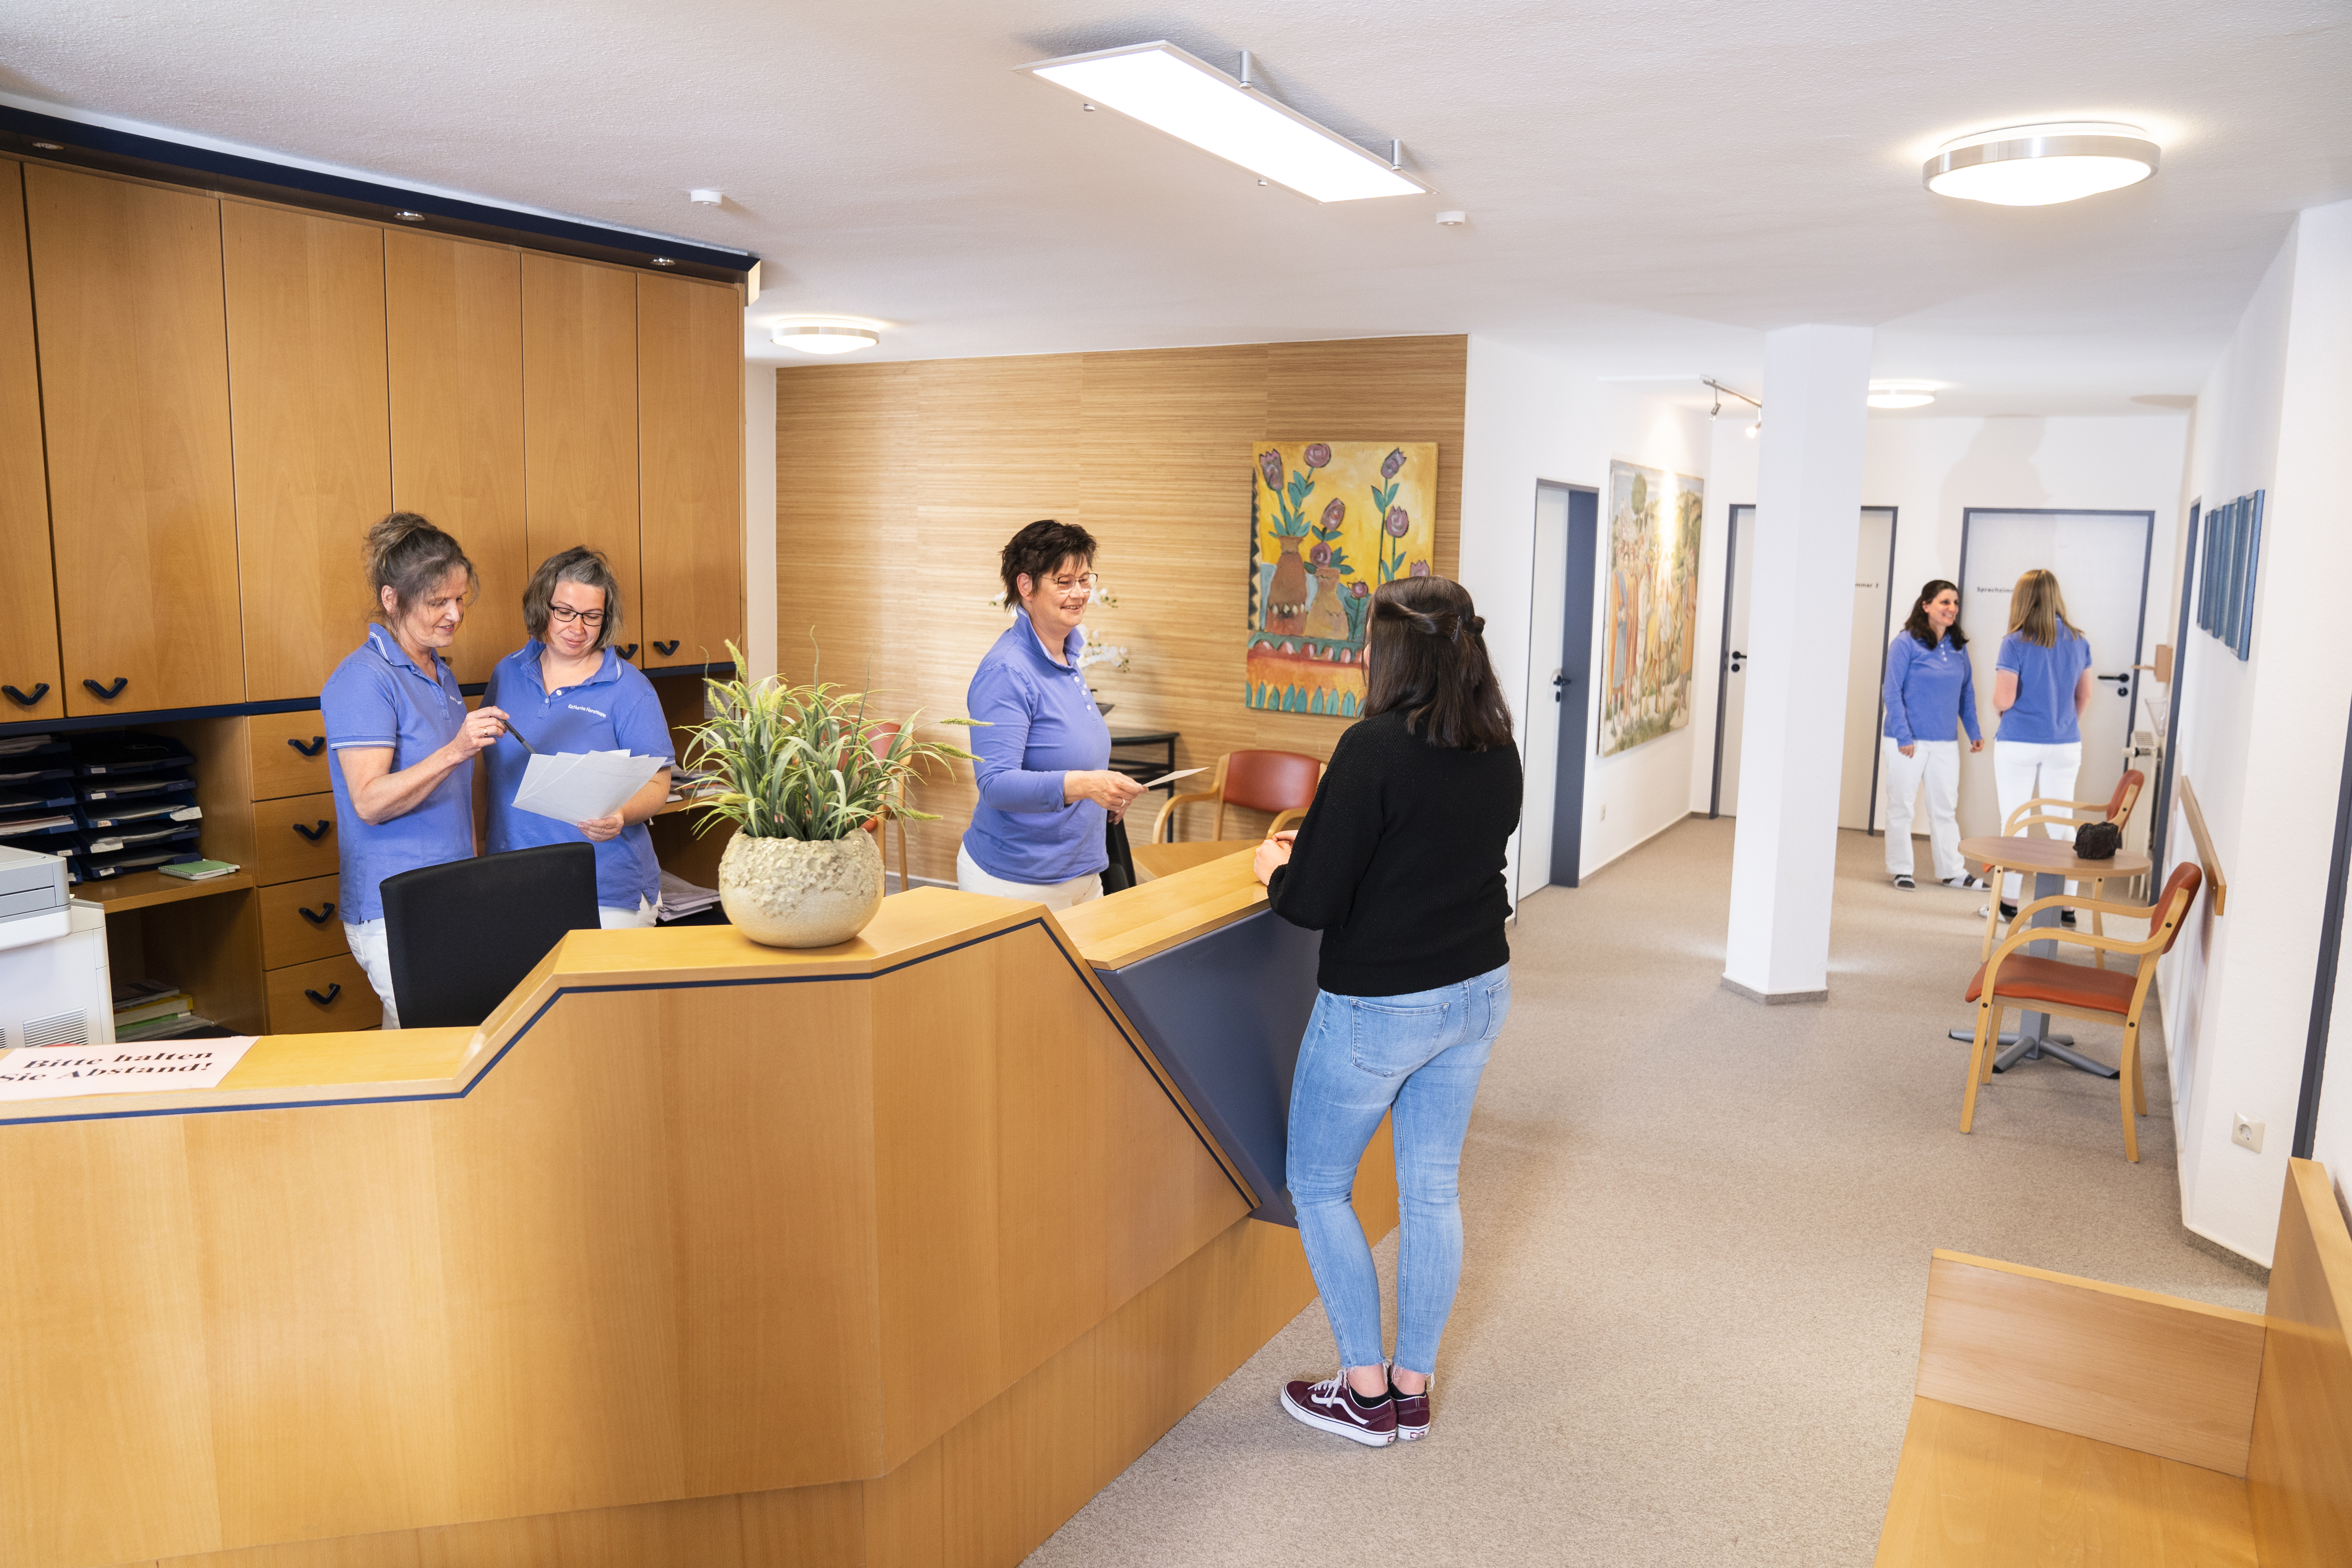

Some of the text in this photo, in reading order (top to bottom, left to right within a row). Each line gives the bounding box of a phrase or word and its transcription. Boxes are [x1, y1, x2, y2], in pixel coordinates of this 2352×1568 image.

[586, 706, 606, 718] Horstmann
[21, 1052, 212, 1069] Bitte halten
[0, 1062, 213, 1082] Sie Abstand!
